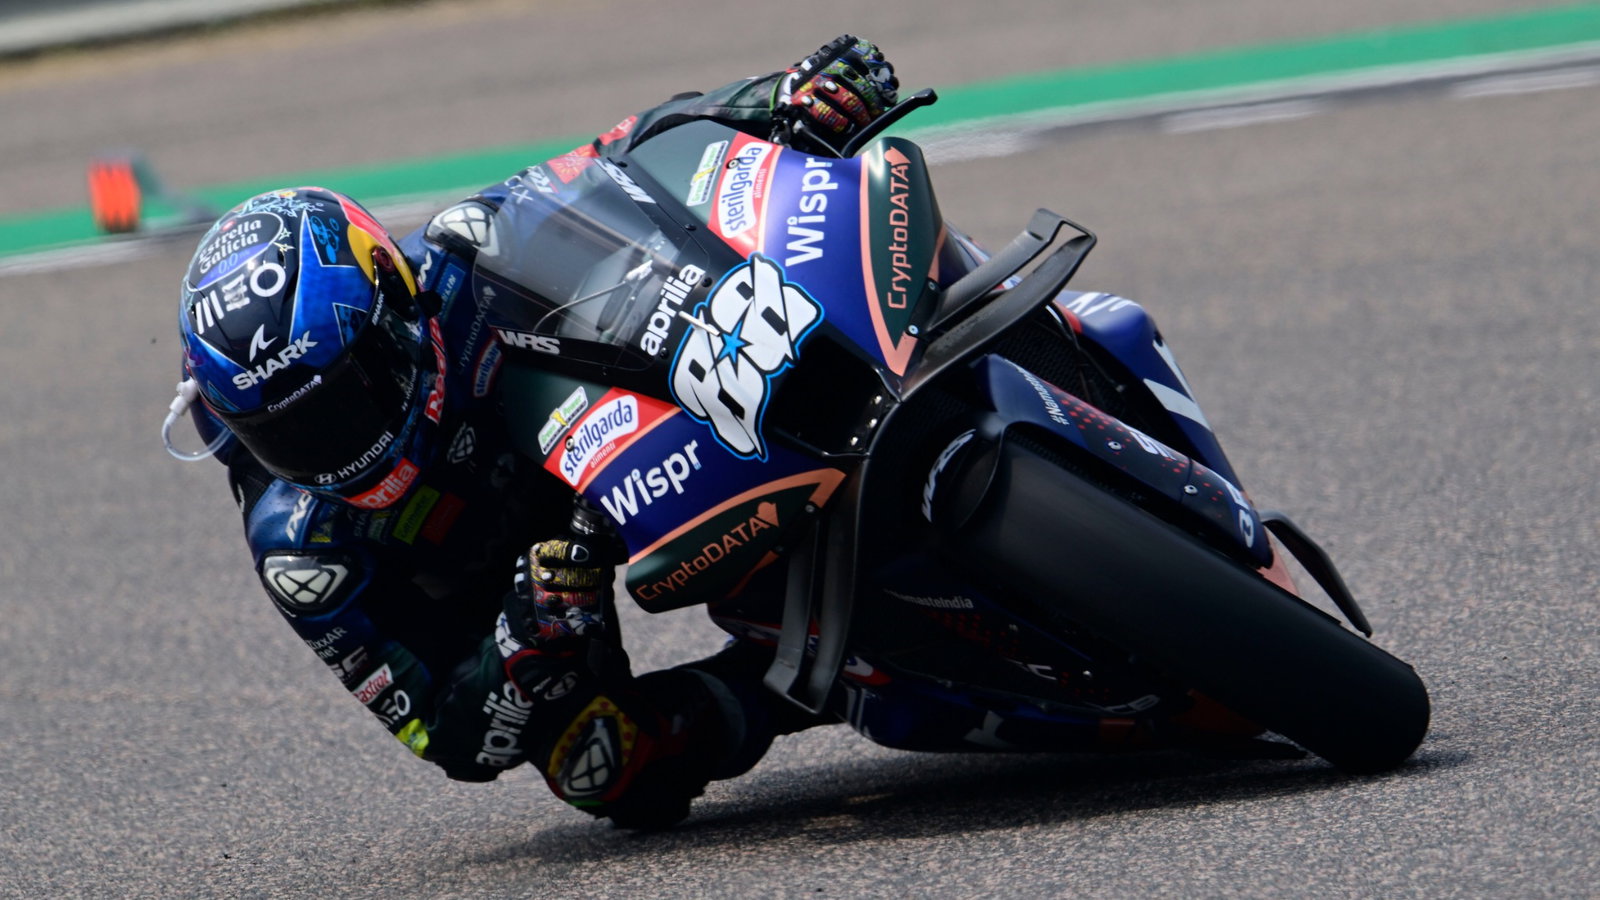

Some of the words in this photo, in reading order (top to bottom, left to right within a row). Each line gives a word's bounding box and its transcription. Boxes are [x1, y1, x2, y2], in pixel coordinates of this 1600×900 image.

[722, 147, 762, 231] sterilgarda
[785, 157, 839, 267] Wispr
[198, 219, 262, 265] Estrella
[200, 232, 259, 274] Galicia
[886, 163, 913, 309] CryptoDATA
[496, 328, 561, 356] WRS
[640, 263, 706, 357] aprilia
[232, 330, 318, 391] SHARK
[670, 251, 824, 463] 88
[267, 380, 318, 413] CryptoDATA
[337, 431, 394, 479] HYUNDAI
[564, 400, 633, 477] sterilgarda
[590, 441, 617, 469] alimenti
[600, 439, 702, 526] Wispr
[636, 516, 771, 600] CryptoDATA
[354, 669, 390, 703] astrol
[476, 680, 534, 767] aprilia
